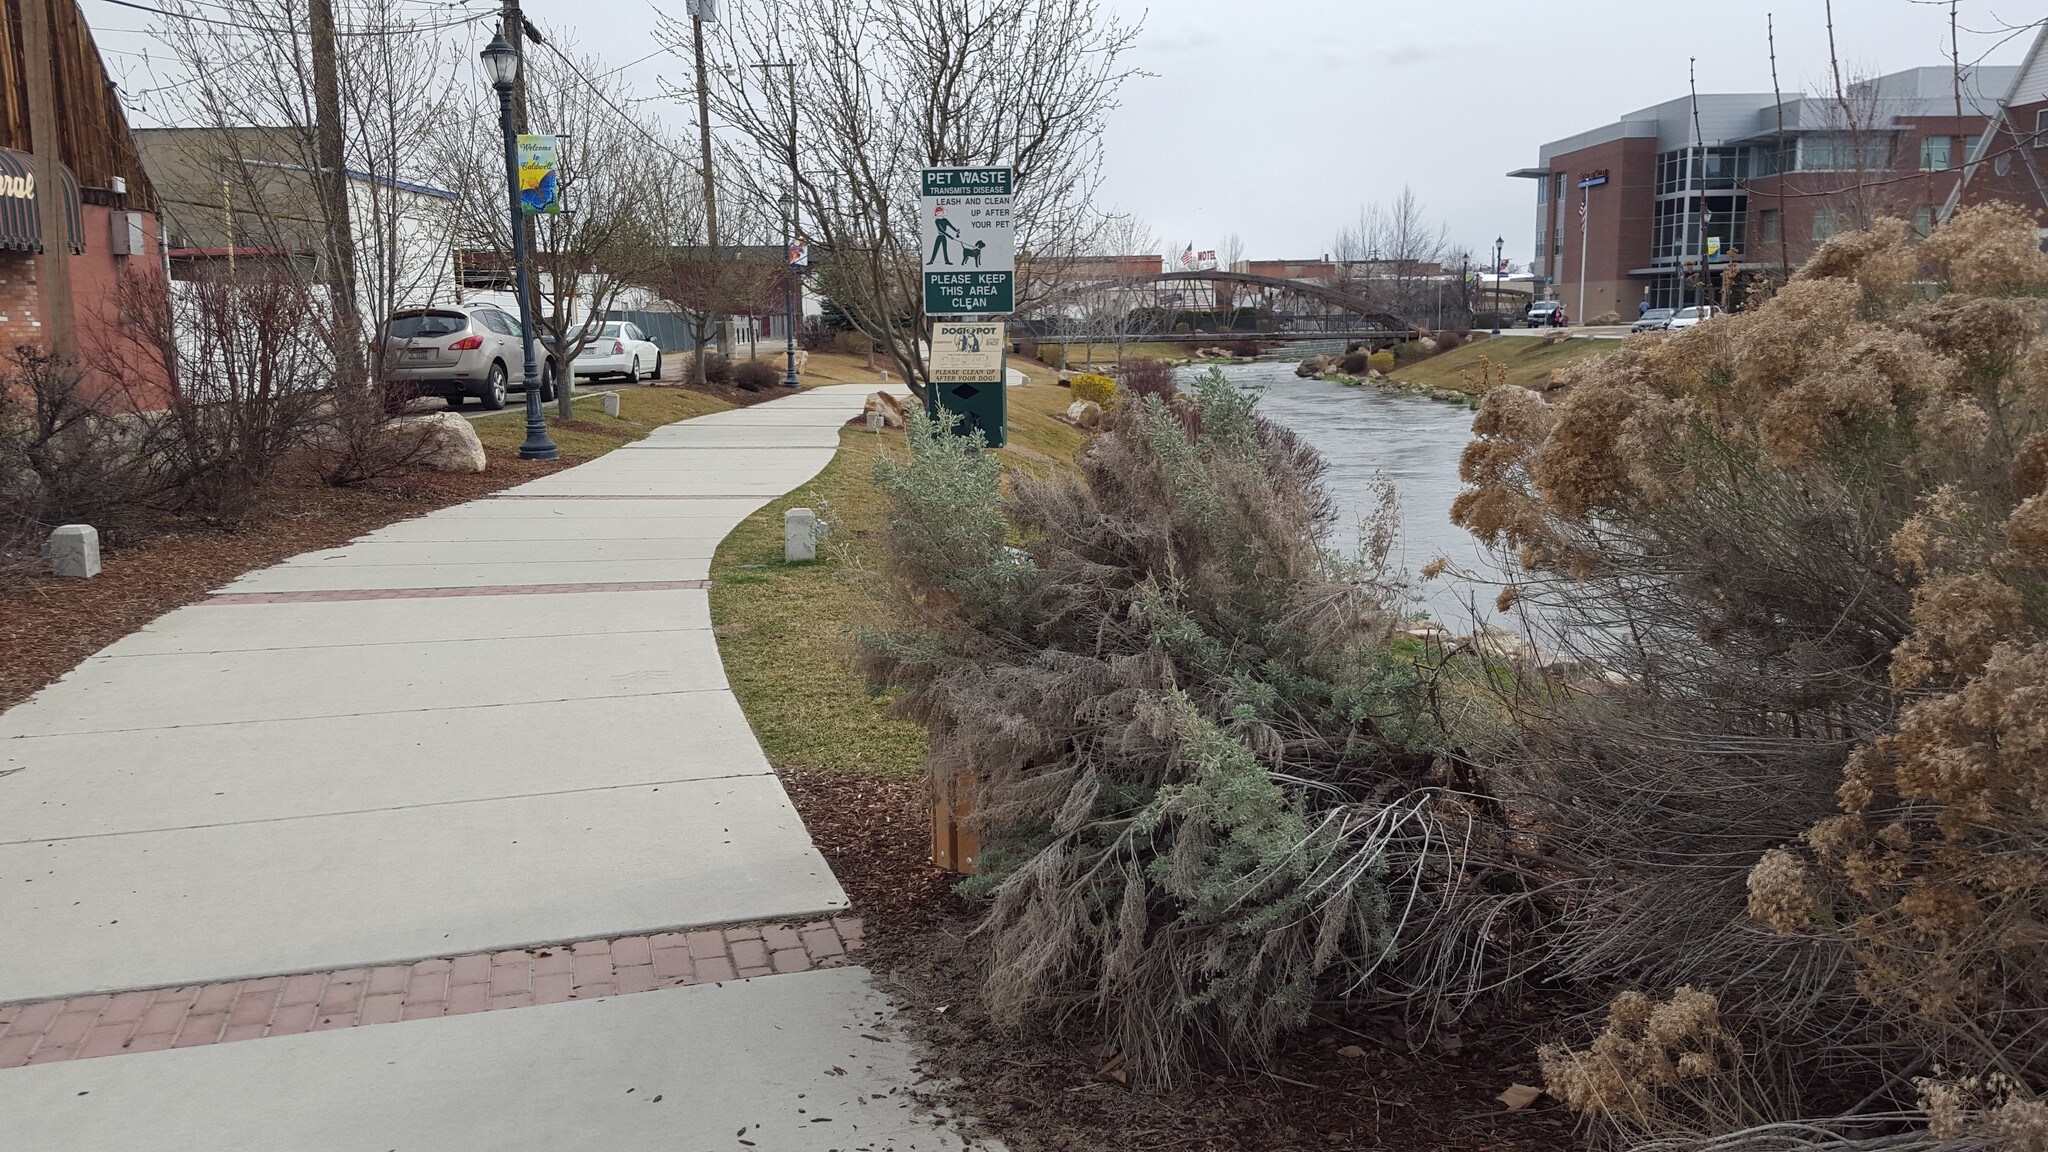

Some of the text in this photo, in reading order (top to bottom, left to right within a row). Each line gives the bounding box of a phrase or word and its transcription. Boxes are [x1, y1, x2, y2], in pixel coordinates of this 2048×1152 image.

[520, 143, 552, 152] Welcome
[521, 162, 553, 171] Caldwell
[927, 171, 1006, 184] PET WASTE
[930, 186, 1004, 195] TRANSMITS DISEASE
[936, 198, 962, 206] LEASH
[984, 197, 1010, 205] CLEAN
[971, 209, 981, 217] UP
[995, 220, 1010, 228] PET
[1197, 250, 1217, 262] MOTEL
[931, 274, 1006, 284] PLEASE KEEP
[940, 286, 998, 296] THIS AREA
[952, 298, 987, 308] CLEAN
